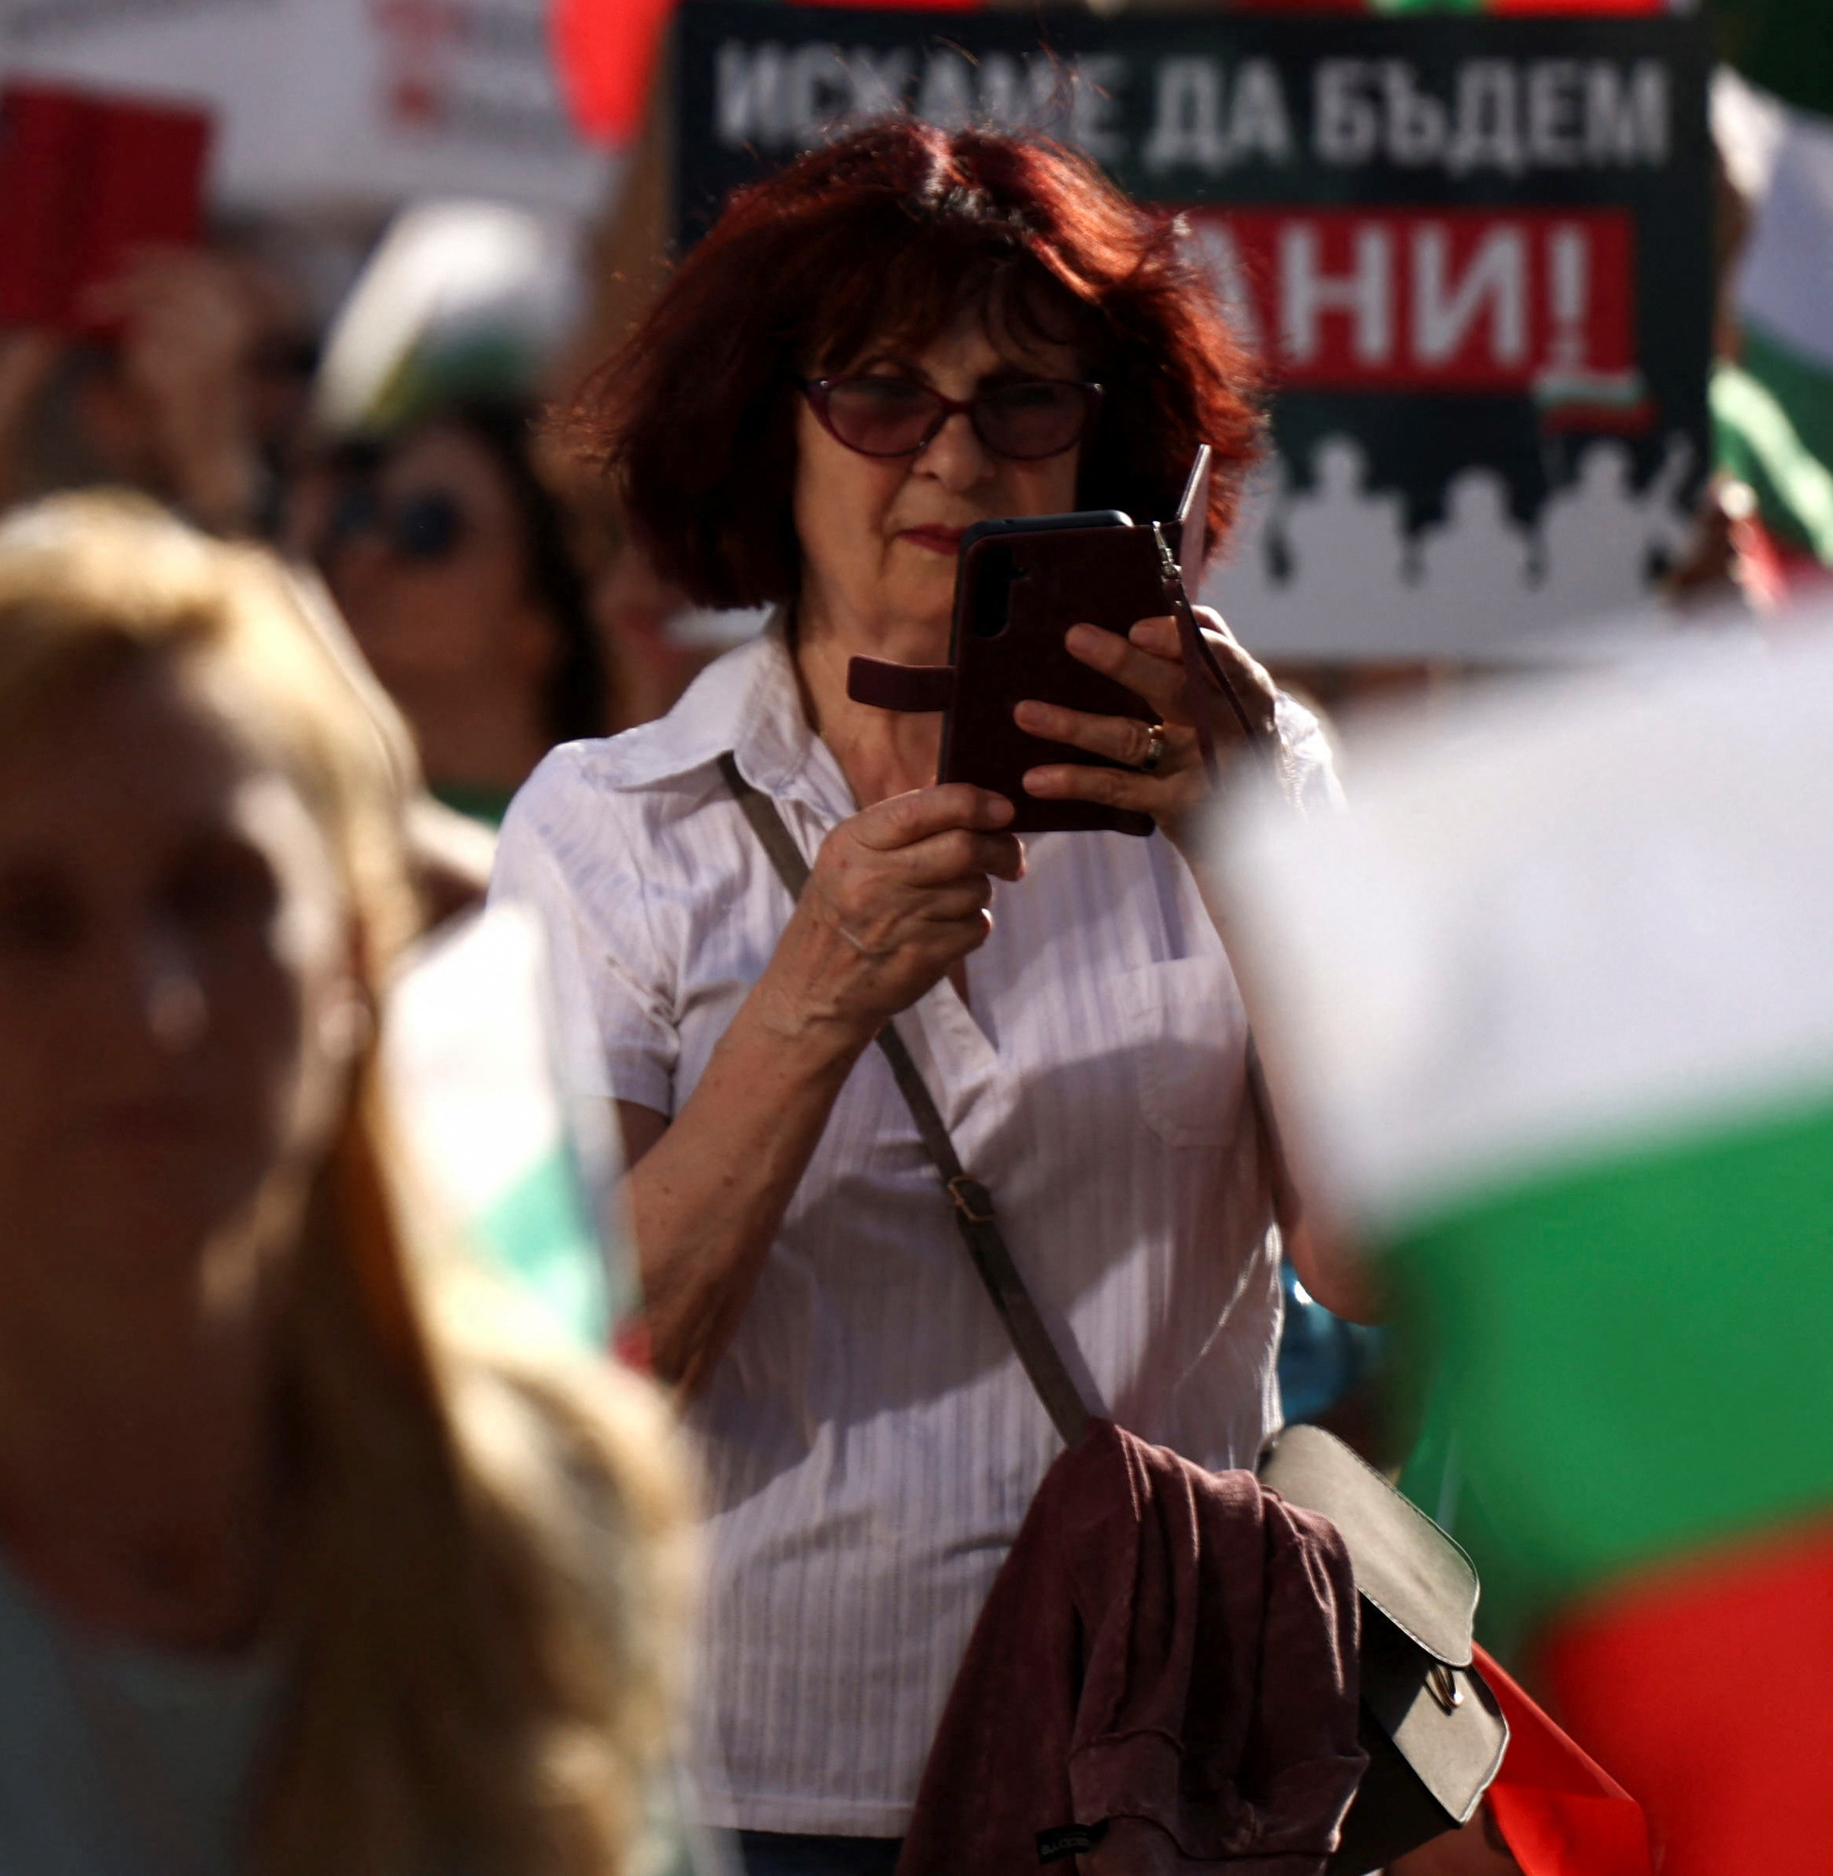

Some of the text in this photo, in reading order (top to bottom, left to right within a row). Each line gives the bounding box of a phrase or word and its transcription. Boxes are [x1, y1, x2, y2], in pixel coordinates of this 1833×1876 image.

[714, 38, 1671, 179] ИСКАМЕ ДА БЪДЕМ
